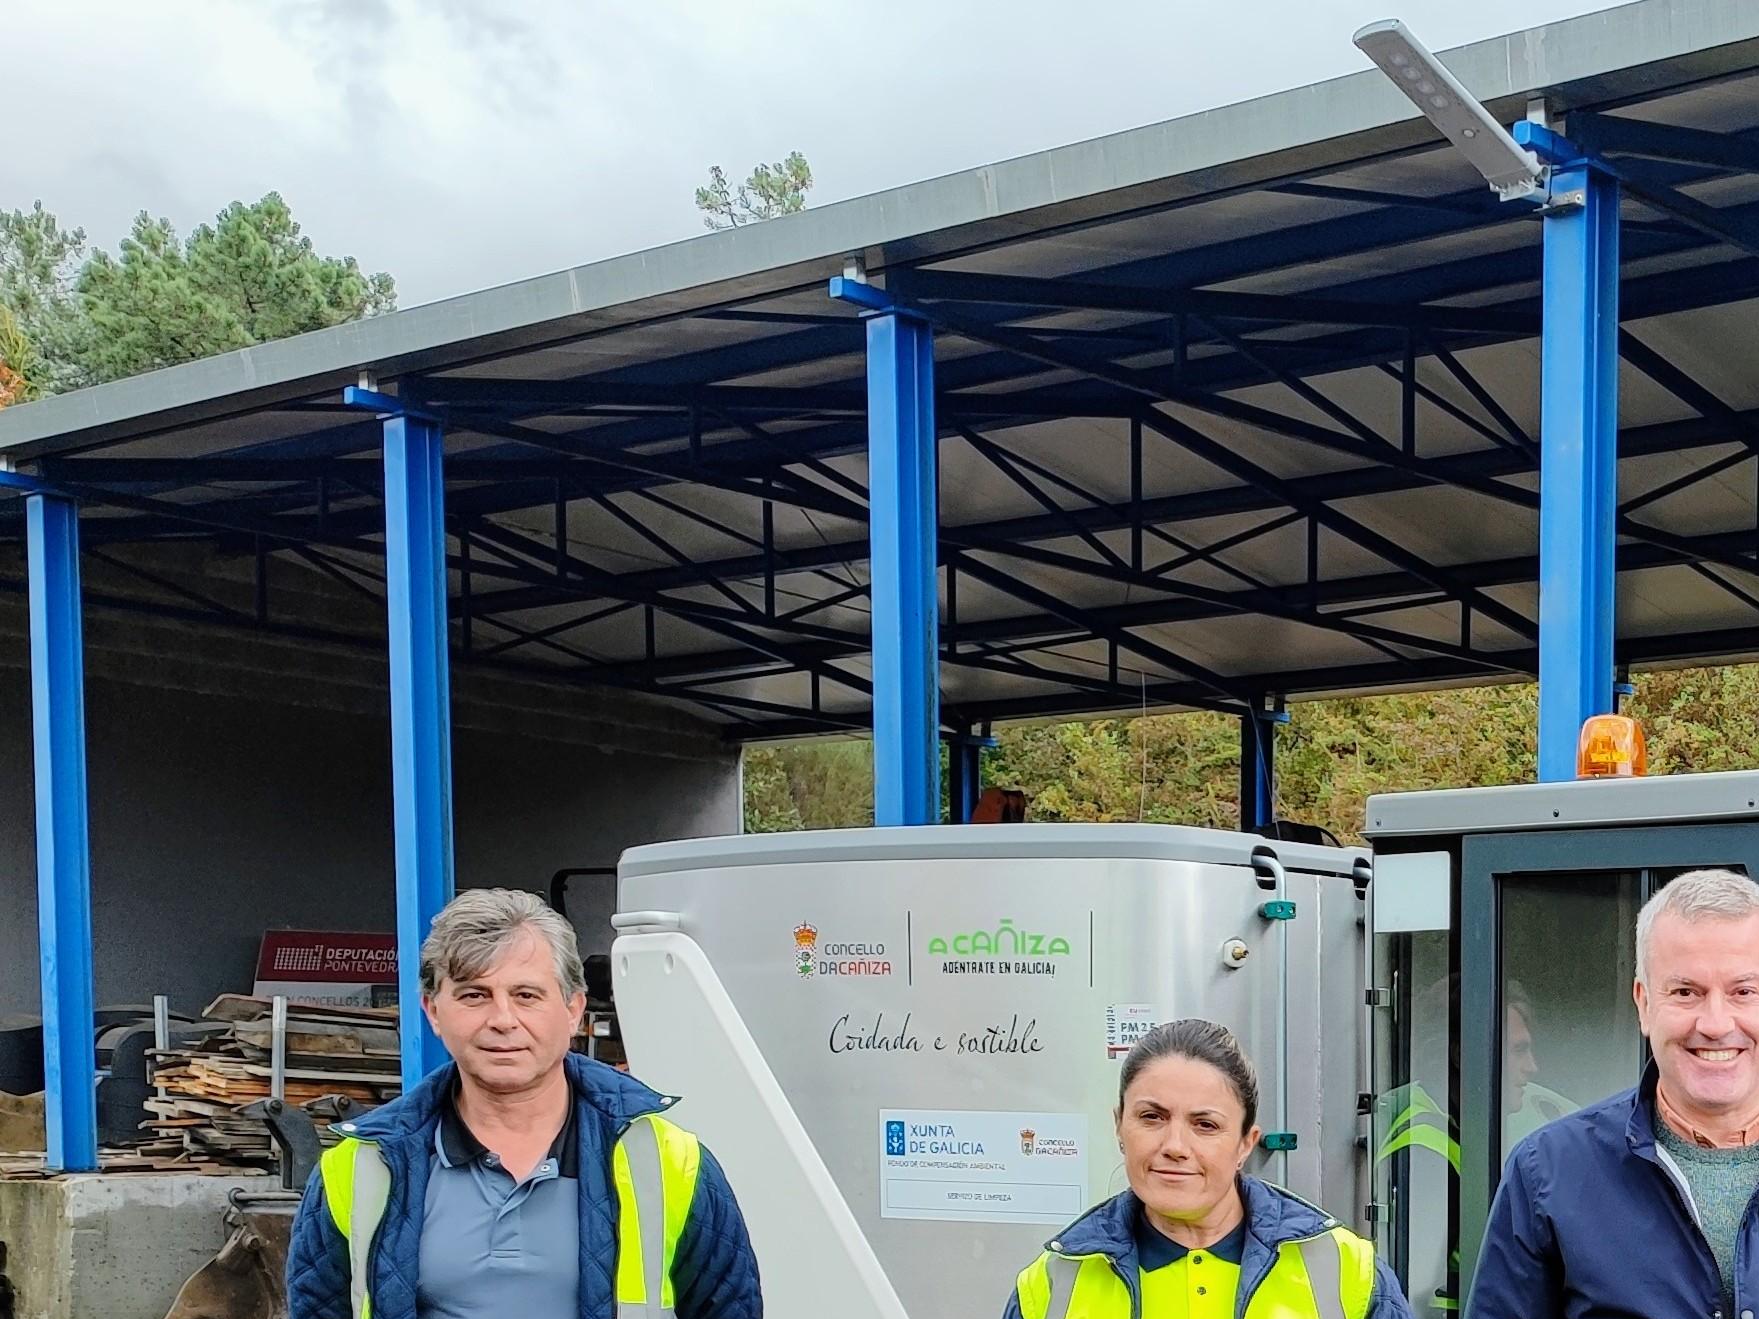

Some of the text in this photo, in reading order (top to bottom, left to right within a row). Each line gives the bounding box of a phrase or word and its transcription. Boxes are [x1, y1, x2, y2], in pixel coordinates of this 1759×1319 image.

[326, 947, 398, 961] DEPUTACIÓ
[825, 944, 885, 956] CONCELLO
[999, 962, 1010, 974] EN
[934, 1037, 947, 1049] e
[910, 1125, 955, 1138] XUNTA
[910, 1141, 985, 1156] DE GALICIA
